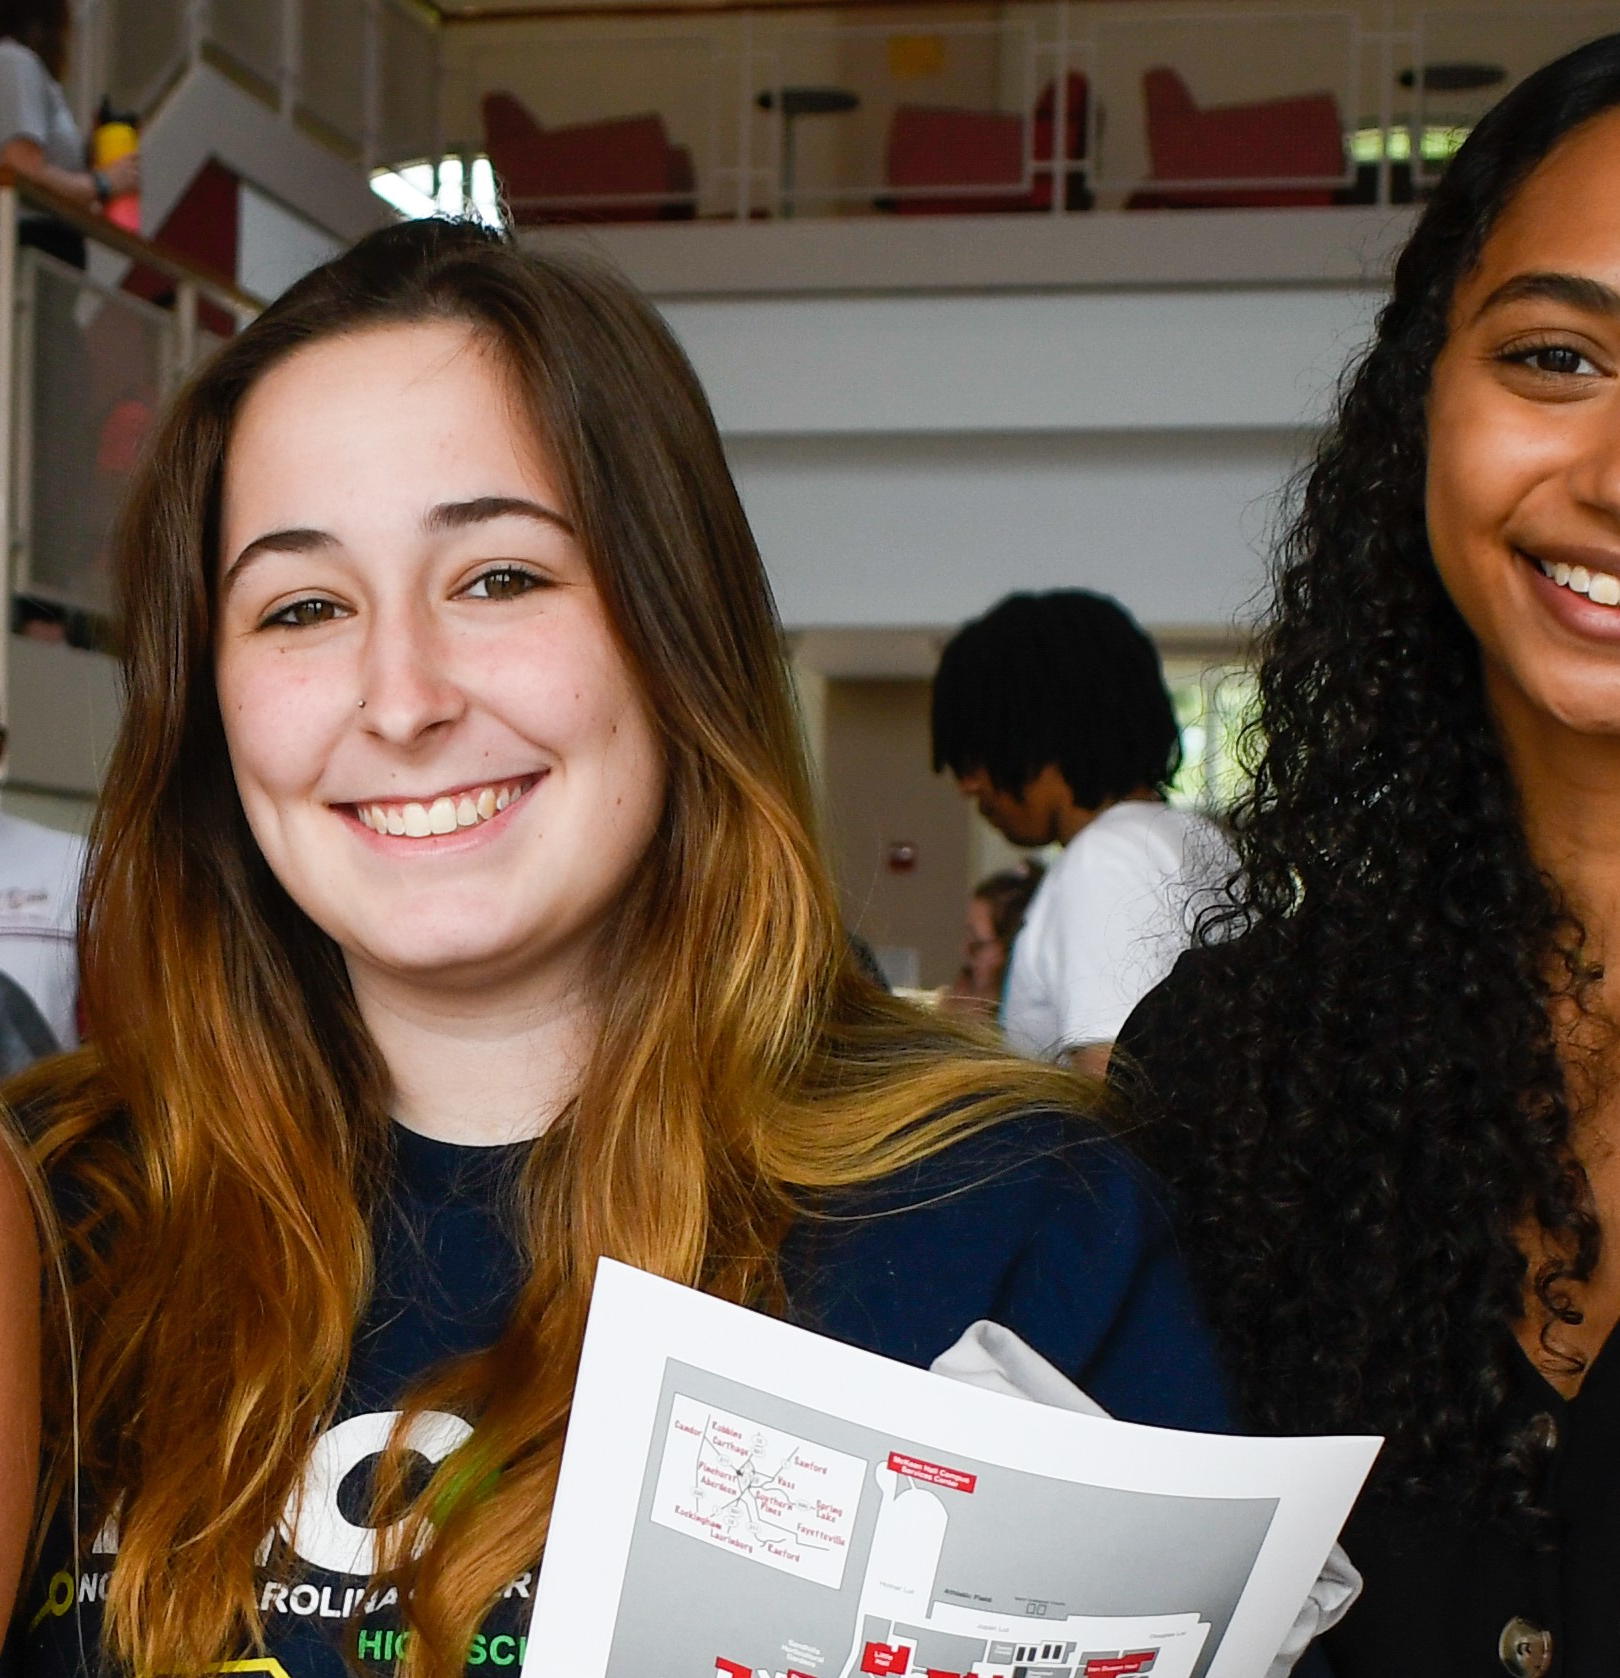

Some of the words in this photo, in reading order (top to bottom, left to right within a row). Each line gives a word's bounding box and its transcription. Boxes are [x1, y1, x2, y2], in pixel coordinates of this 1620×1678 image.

[712, 1436, 749, 1457] Carthage
[698, 1461, 738, 1483] Pinehurst
[794, 1456, 828, 1475] Sanford
[700, 1476, 738, 1496] Aberdeen
[756, 1491, 793, 1511] Southern
[816, 1500, 843, 1517] Spring
[674, 1505, 723, 1530] Rockingham
[816, 1510, 836, 1523] Lake
[710, 1529, 753, 1553] Laurinburg
[796, 1523, 846, 1546] Fayetteville
